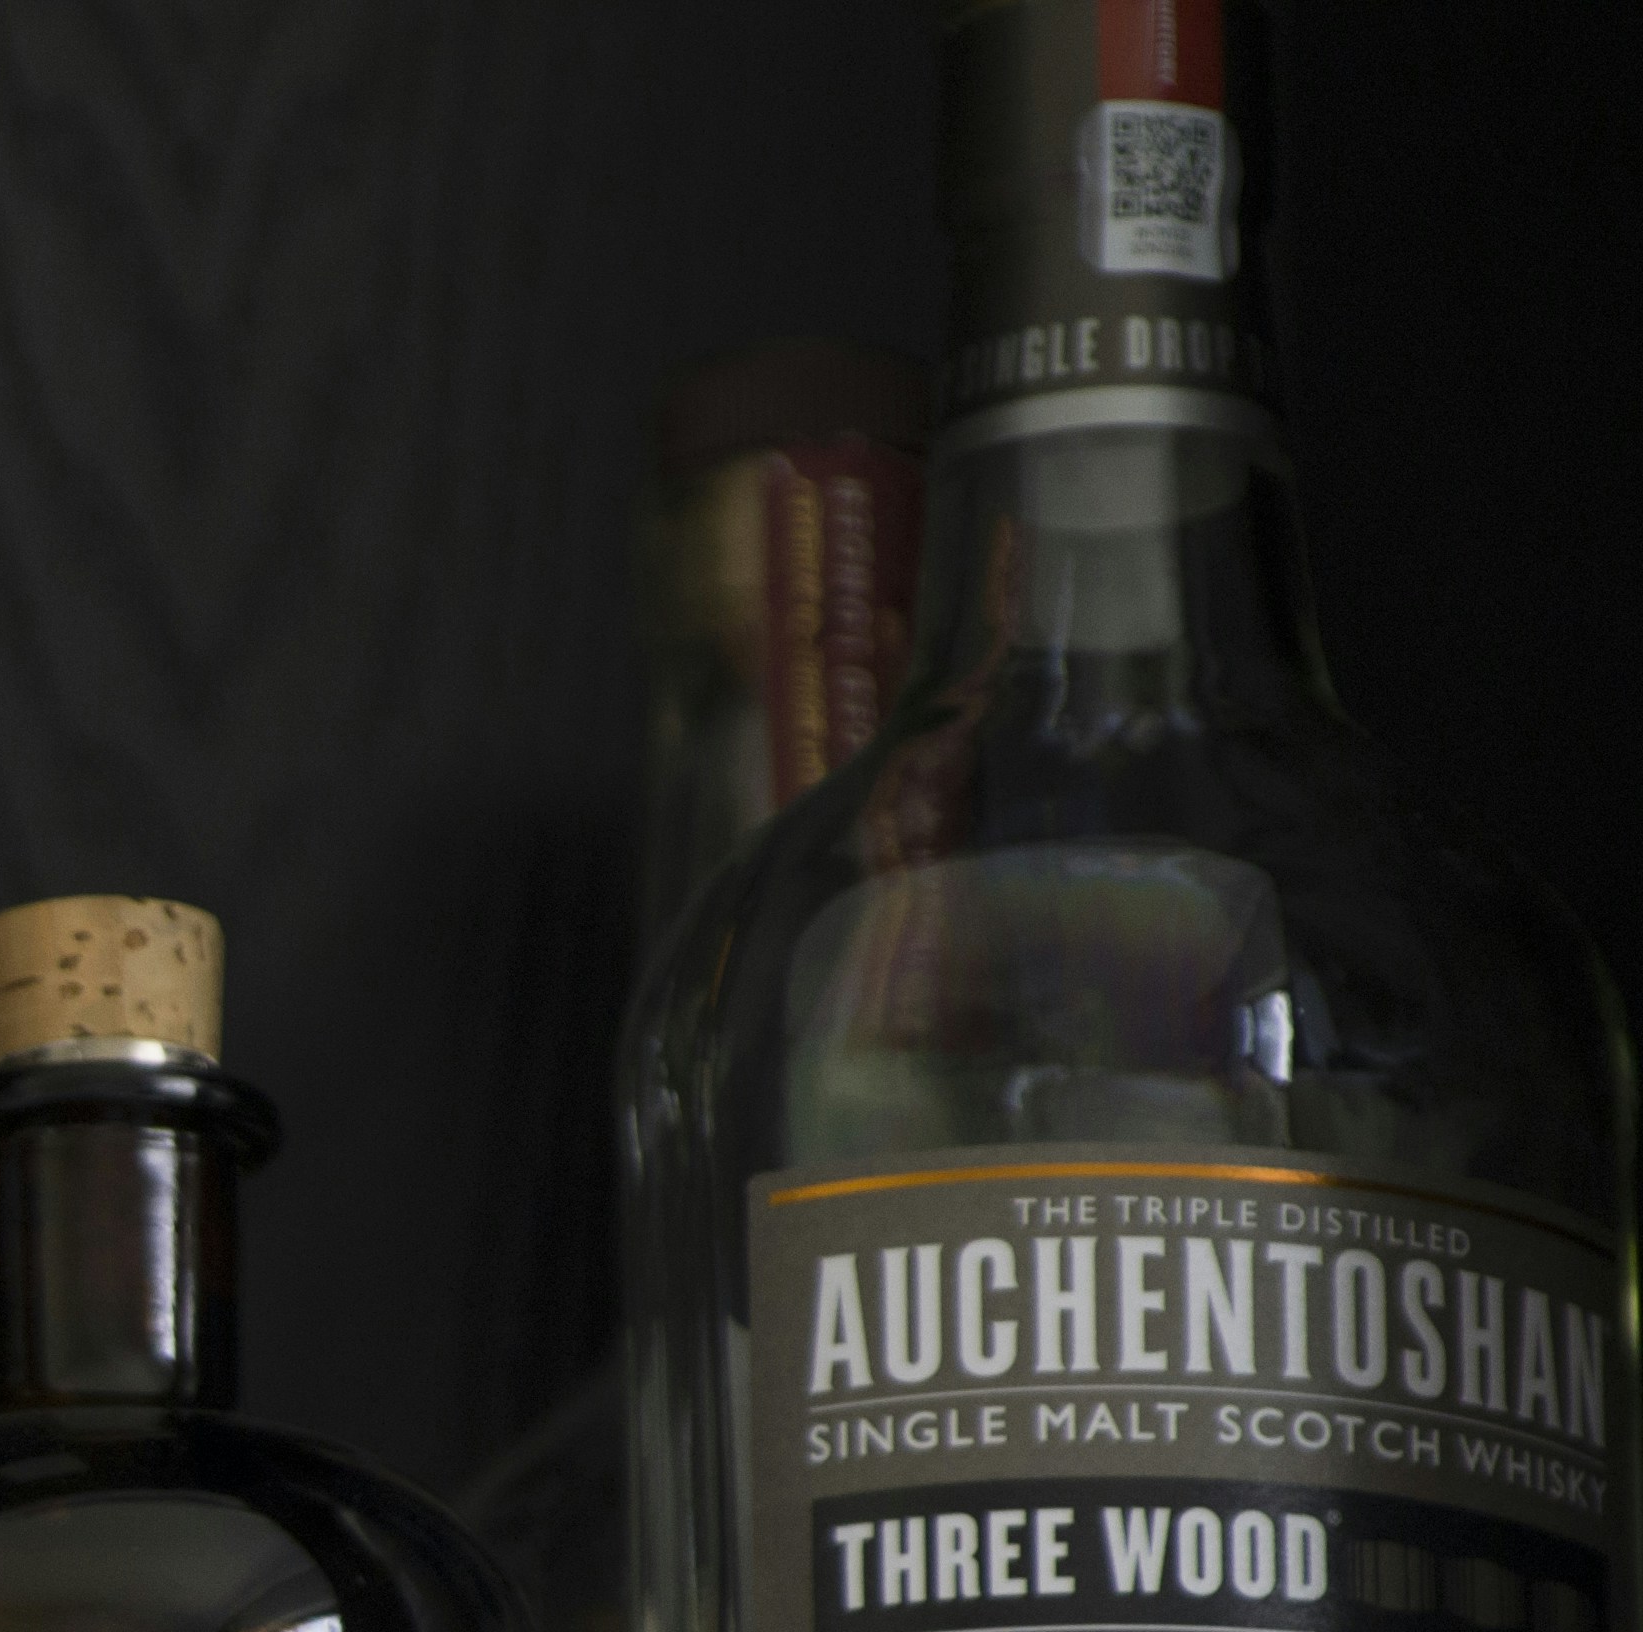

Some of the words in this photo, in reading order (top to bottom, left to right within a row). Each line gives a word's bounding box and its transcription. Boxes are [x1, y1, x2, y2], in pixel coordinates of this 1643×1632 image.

[1013, 1197, 1097, 1227] THE
[1116, 1195, 1258, 1230] TRIPLE
[1279, 1202, 1472, 1258] DISTILLED
[810, 1236, 1608, 1449] AUCHENTOSHAN
[808, 1404, 1006, 1464] SINGLE
[1036, 1402, 1189, 1446] MALT
[1219, 1405, 1440, 1468] SCOTCH
[1458, 1432, 1608, 1516] WHISKY
[834, 1507, 1076, 1611] THREE
[1101, 1507, 1328, 1602] WOOD
